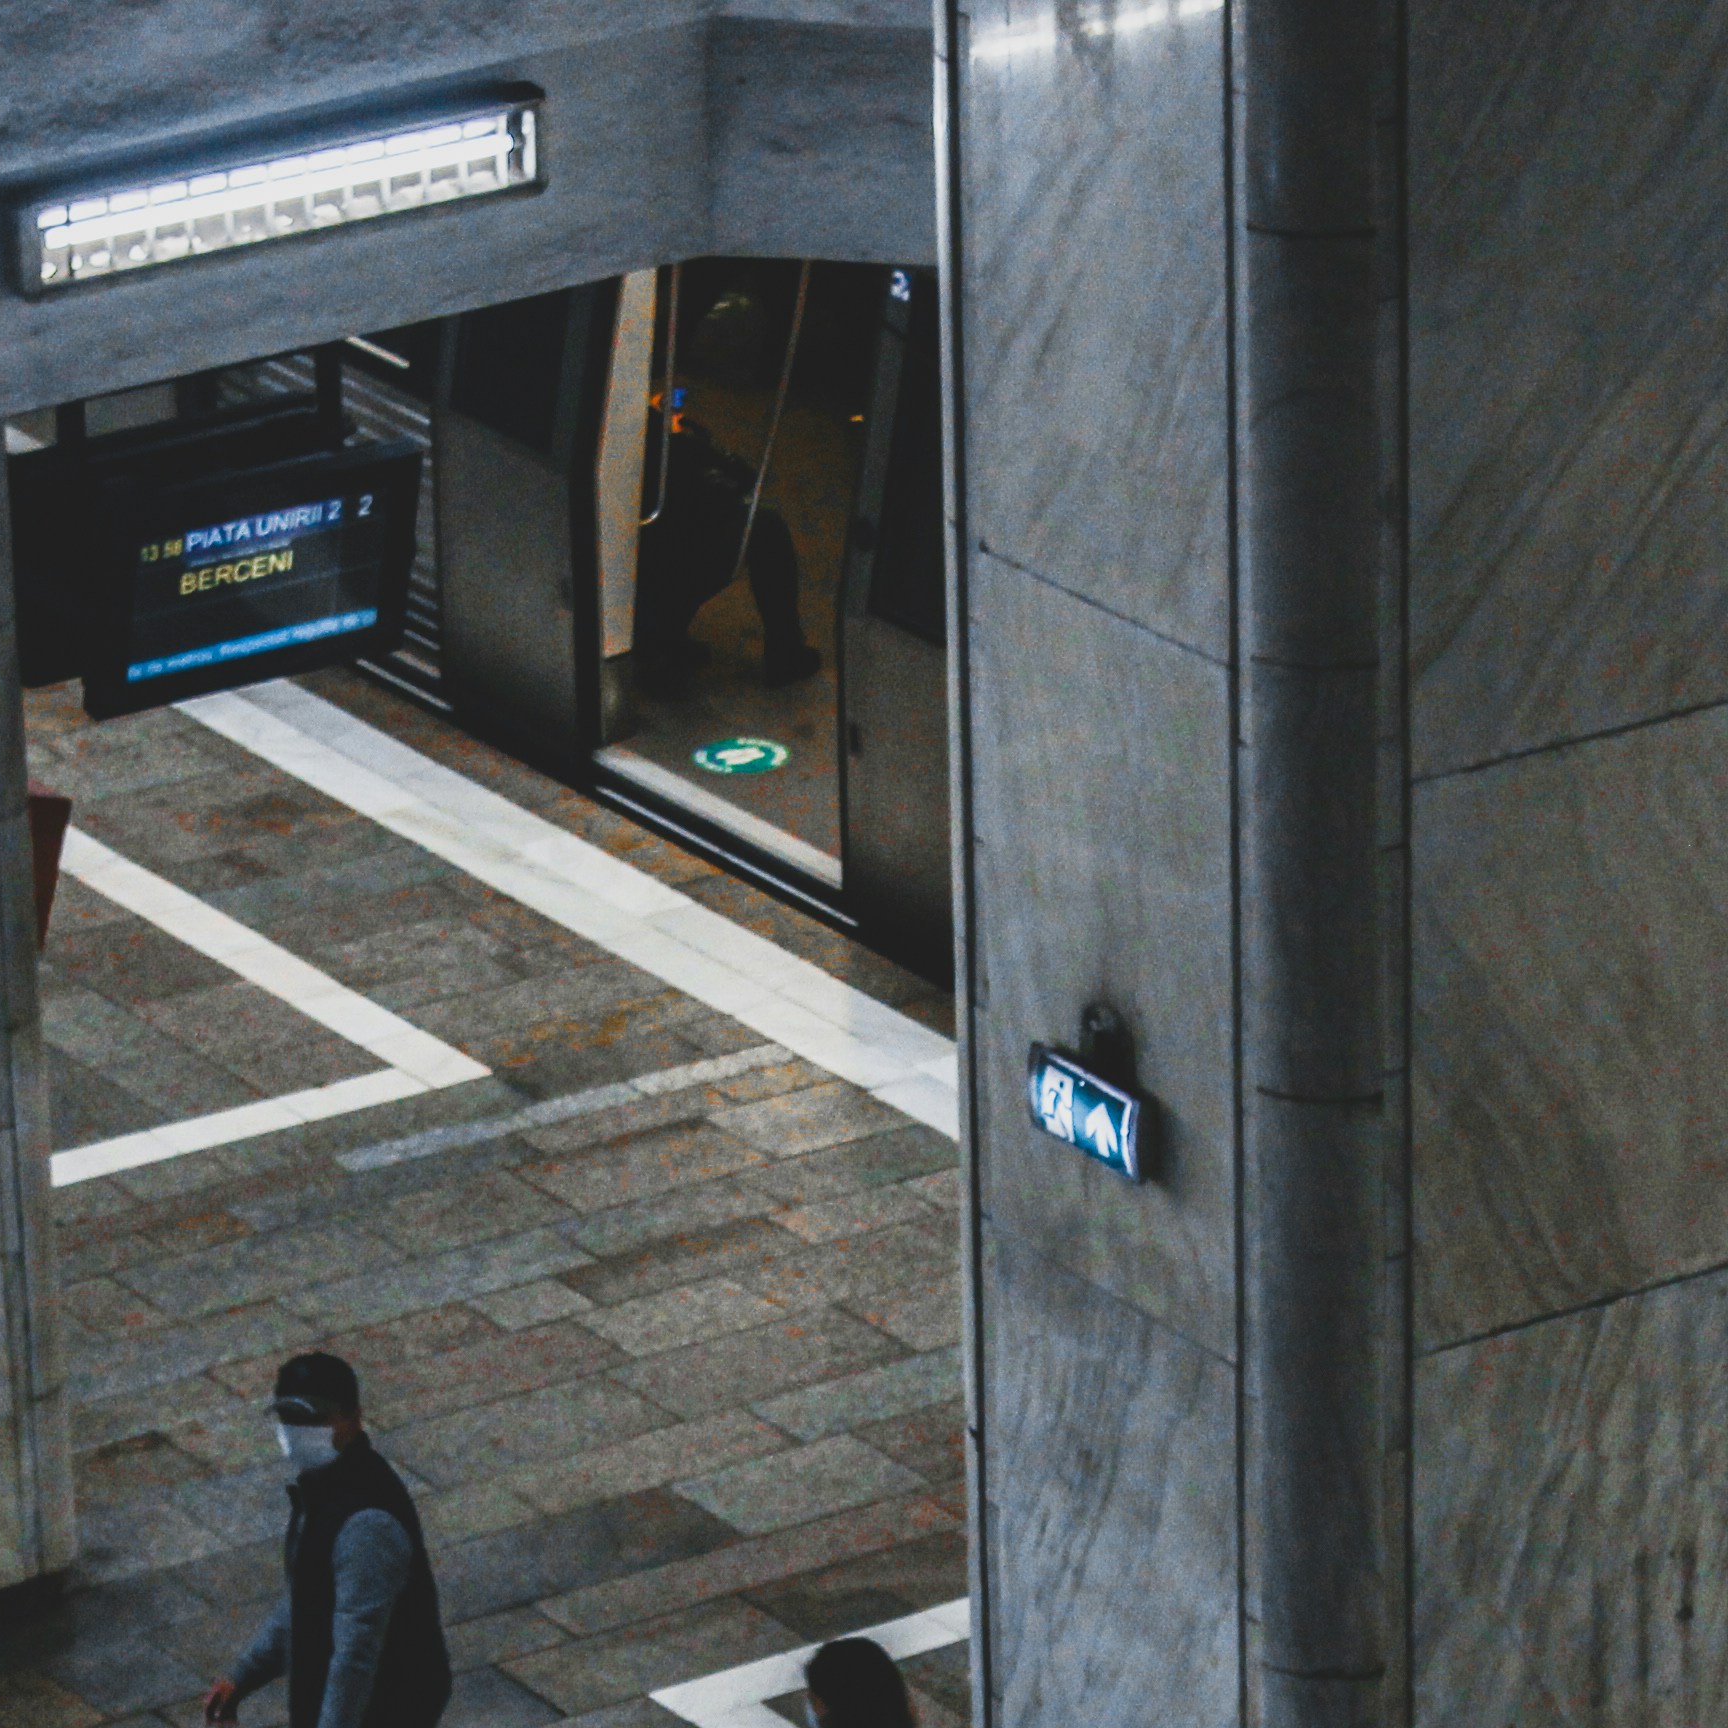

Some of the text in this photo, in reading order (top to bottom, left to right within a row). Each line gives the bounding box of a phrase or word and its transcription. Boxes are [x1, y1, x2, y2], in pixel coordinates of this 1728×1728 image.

[185, 522, 251, 552] PIATA
[255, 503, 323, 536] UNIRII
[327, 500, 343, 521] 2
[357, 494, 374, 517] 2
[179, 550, 295, 596] BERCENI
